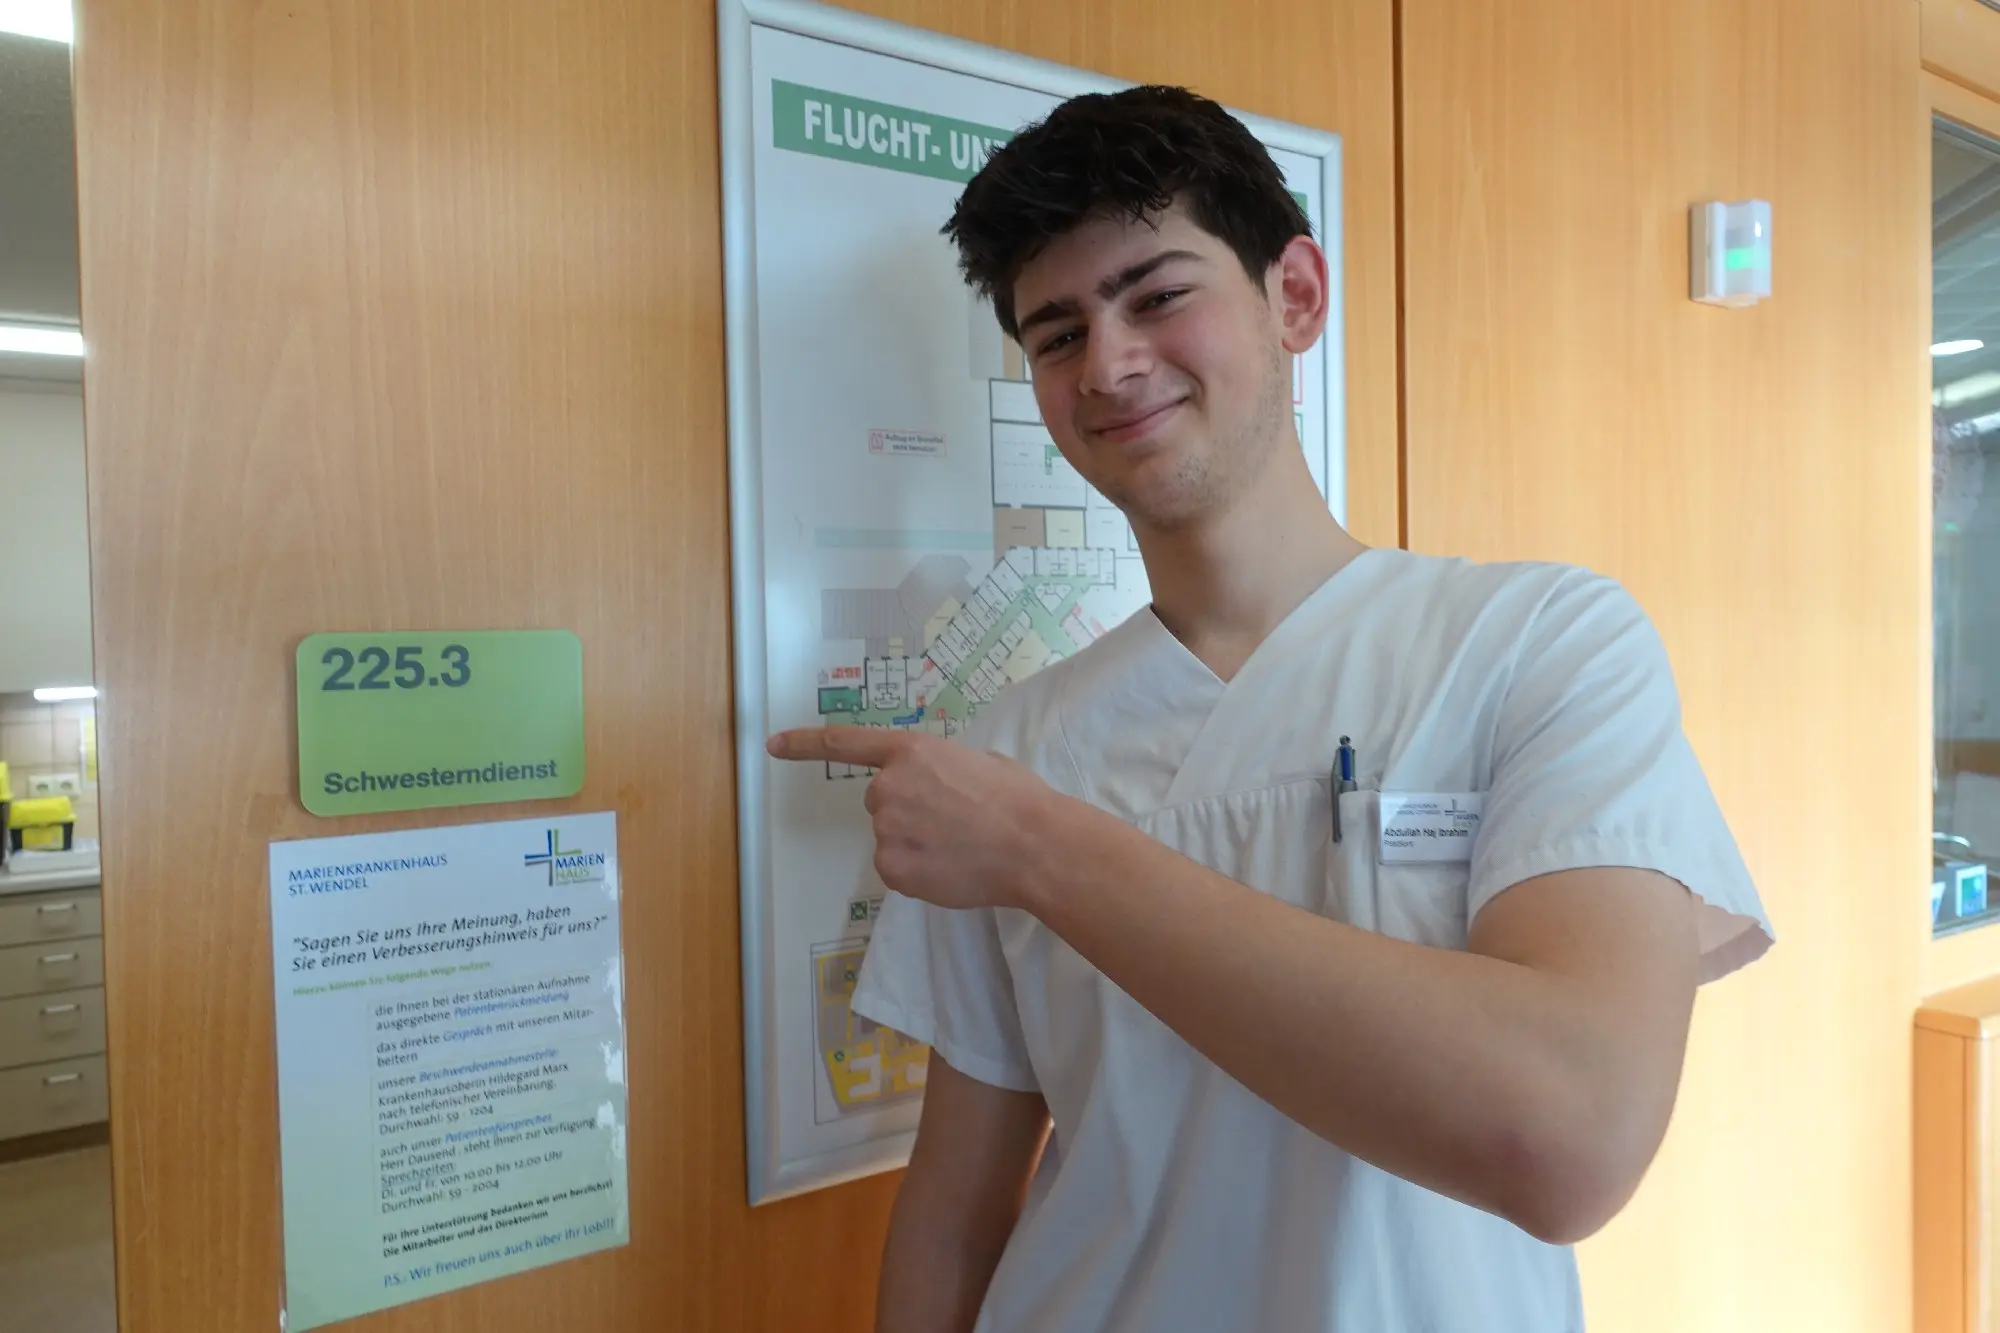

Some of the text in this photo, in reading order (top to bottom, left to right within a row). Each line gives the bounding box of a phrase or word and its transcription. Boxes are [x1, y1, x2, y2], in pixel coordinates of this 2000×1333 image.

[804, 100, 1007, 174] FLUCHT- UN
[321, 644, 471, 691] 225.3
[324, 760, 558, 795] Schwesterndienst
[288, 854, 448, 882] MARIENKRANKENHAUS
[556, 853, 604, 868] MARIEN
[556, 868, 590, 879] HAUS
[310, 877, 369, 894] WENDEL
[356, 929, 379, 945] Sie
[384, 926, 412, 940] uns
[417, 921, 447, 936] Ihre
[452, 912, 522, 932] Meinung,
[526, 906, 571, 921] haben
[292, 957, 316, 972] Sie
[322, 950, 366, 967] einen
[372, 926, 538, 960] Verbesserungshinweis
[540, 922, 564, 942] für
[375, 974, 590, 1017] die Ihnen bei der stationären Aufnahme
[376, 990, 569, 1031] ausgegebene Patientenrückmeldung
[377, 1008, 595, 1054] das direkte Gespräch mit unseren Mitar-
[377, 1052, 418, 1068] beitern
[378, 1075, 416, 1091] unsere
[378, 1063, 569, 1107] Krankenhausoberin Hildegard Marx
[379, 1108, 406, 1121] nach
[410, 1094, 480, 1115] telefonischer
[380, 1144, 407, 1159] auch
[411, 1138, 441, 1152] unser
[380, 1159, 404, 1172] Herr
[464, 1140, 490, 1154] steht
[494, 1133, 522, 1147] Ihnen
[526, 1130, 540, 1140] zur
[400, 1182, 421, 1196] und
[440, 1174, 460, 1186] von
[496, 1163, 511, 1174] bis
[544, 1150, 563, 1162] Uhr
[383, 1232, 397, 1244] Für
[400, 1228, 419, 1240] Ihre
[422, 1211, 488, 1234] Unterstützung
[491, 1200, 534, 1217] bedanken
[536, 1196, 550, 1206] wir
[552, 1192, 567, 1202] uns
[383, 1210, 548, 1258] Die Mitarbeiter und das Direktorium
[409, 1266, 432, 1281] Wir
[436, 1256, 476, 1274] freuen
[479, 1249, 501, 1263] uns
[504, 1240, 532, 1256] auch
[536, 1232, 561, 1248] über
